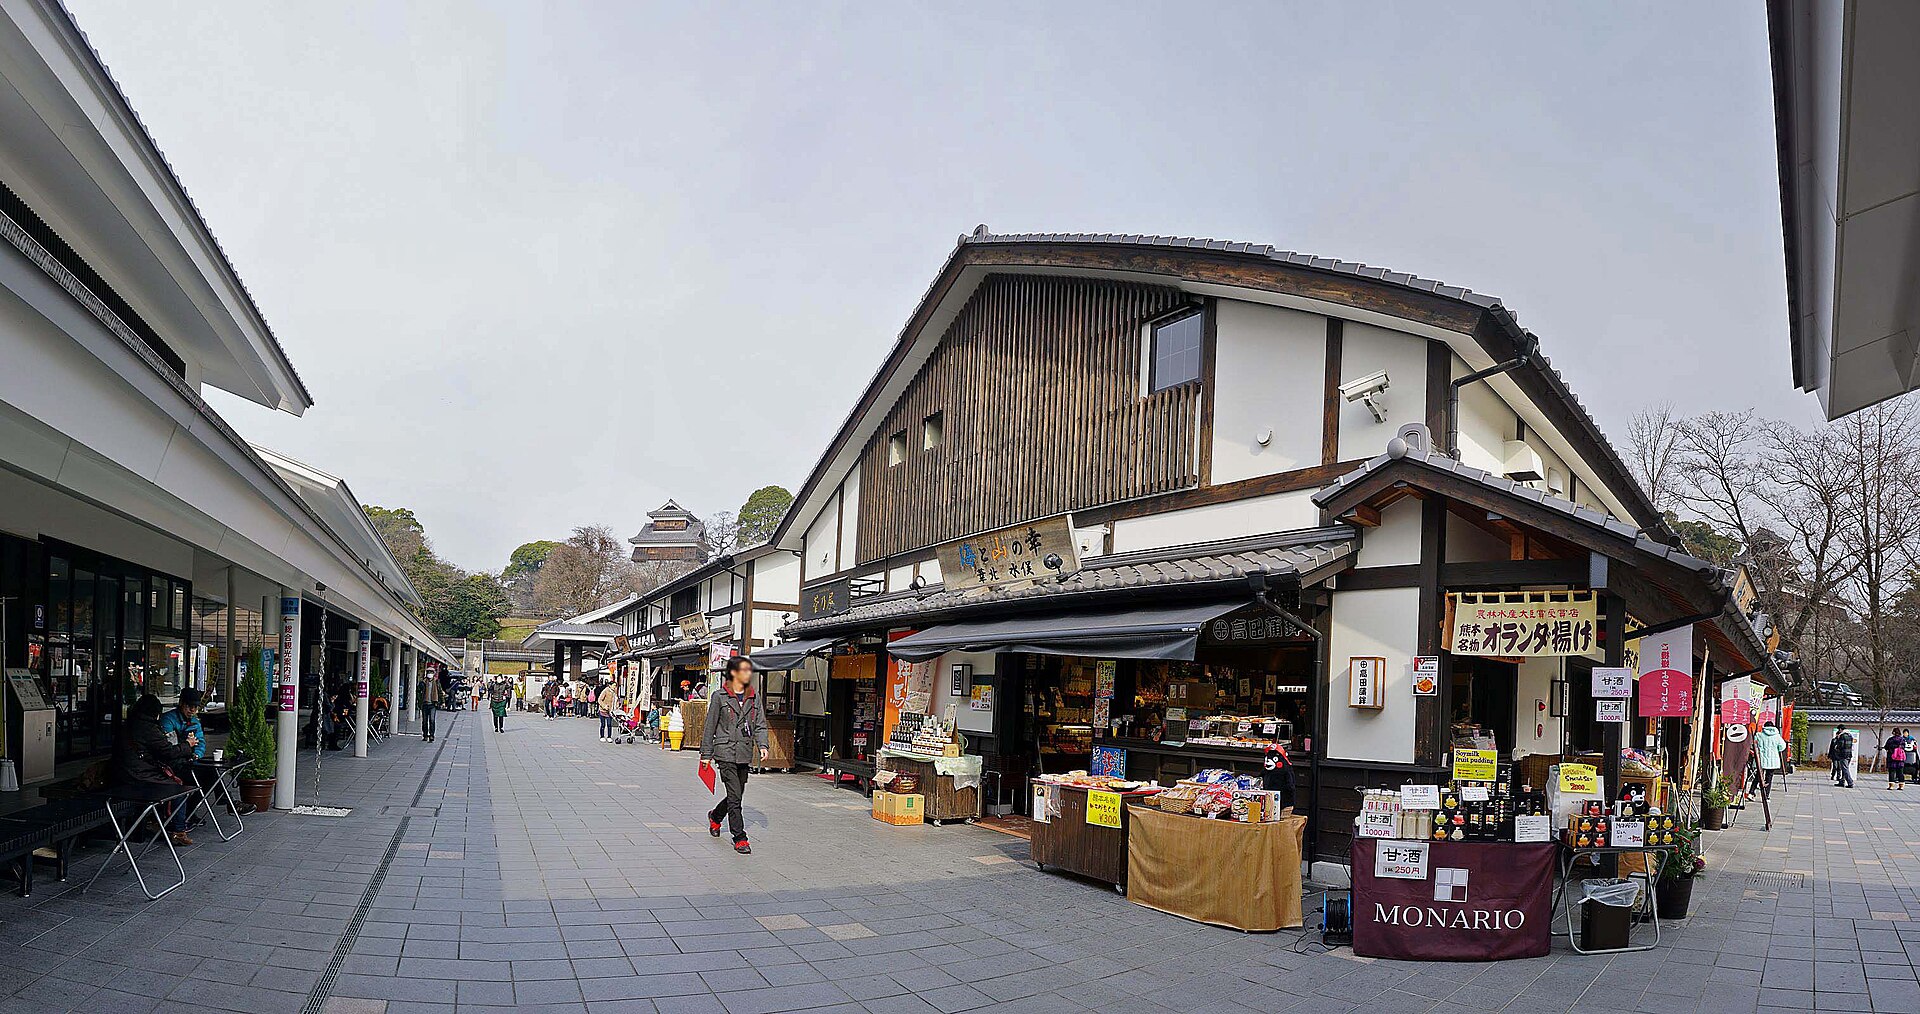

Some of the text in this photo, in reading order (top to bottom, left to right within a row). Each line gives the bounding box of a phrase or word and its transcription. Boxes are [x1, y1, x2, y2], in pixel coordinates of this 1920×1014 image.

[958, 526, 1042, 569] 海と山の幸
[1476, 608, 1580, 619] 農林水産大臣賞受賞店
[1459, 623, 1481, 637] 熊本
[1482, 619, 1593, 653] オランダ揚げ
[1457, 638, 1480, 652] 名物
[283, 625, 293, 682] 総合観光案内所
[1602, 677, 1624, 686] 甘酒
[1602, 703, 1620, 711] 甘酒
[1455, 750, 1480, 758] Soymilk
[1367, 814, 1390, 824] 甘酒
[1365, 828, 1390, 837] 1000円
[1382, 847, 1423, 863] 甘酒
[1394, 865, 1420, 874] 250円
[1373, 902, 1525, 930] MONARIO
